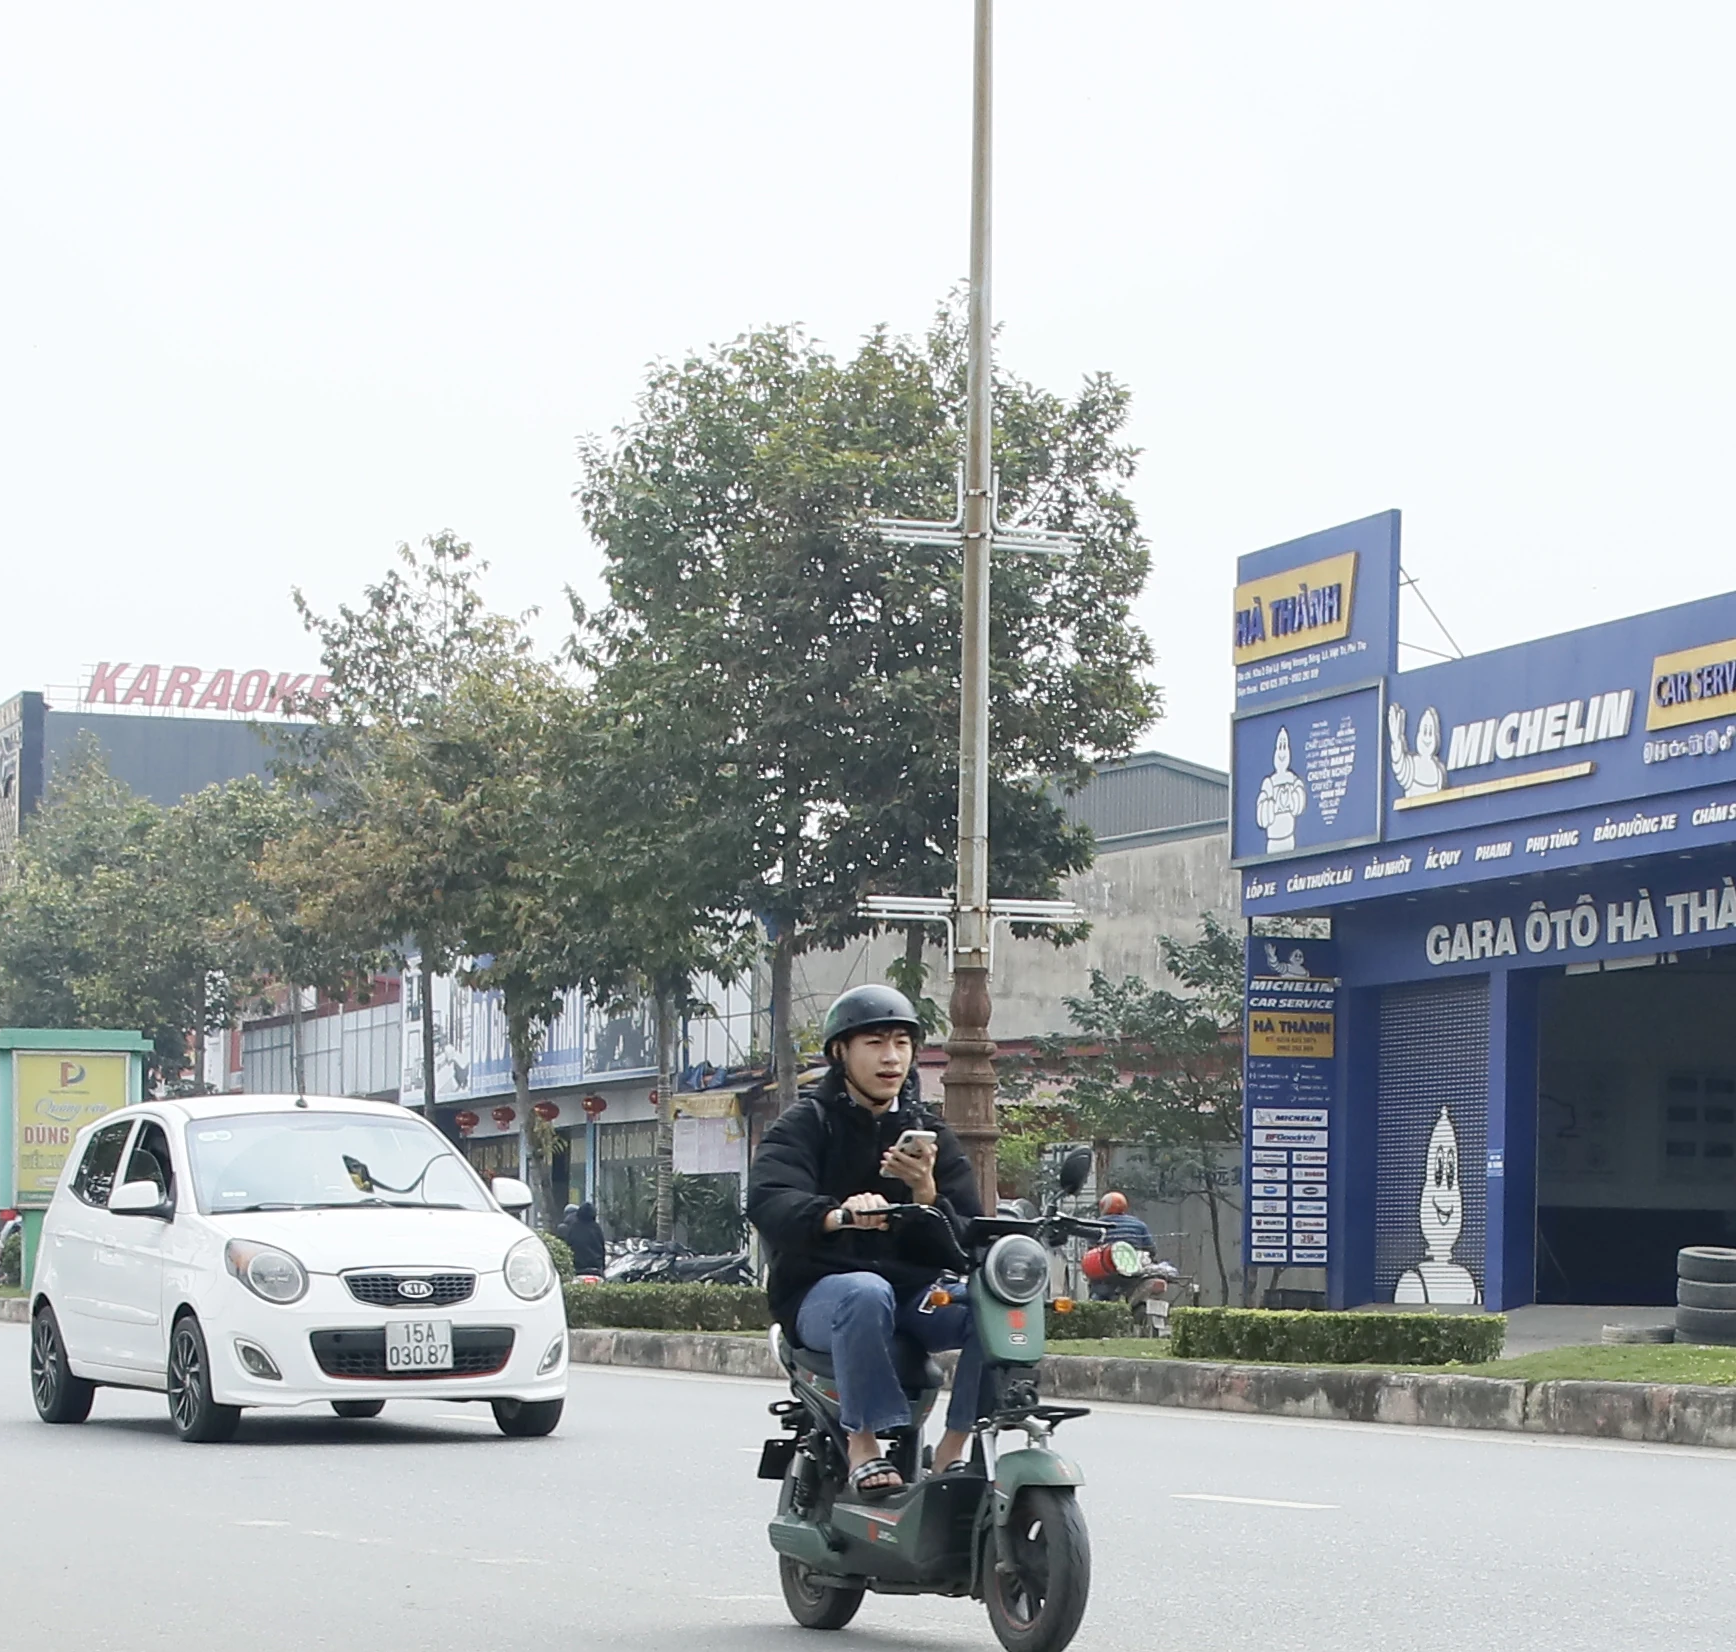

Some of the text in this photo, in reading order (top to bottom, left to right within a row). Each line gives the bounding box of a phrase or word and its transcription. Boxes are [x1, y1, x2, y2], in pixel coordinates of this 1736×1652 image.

[1235, 583, 1342, 648] HÀ THÀNH
[1654, 669, 1692, 707] CAR
[1447, 688, 1636, 772] MICHELIN
[1692, 801, 1729, 826] CHĂM
[1593, 813, 1678, 842] BẢO DƯỠNG XE
[1475, 841, 1513, 862] PHANH
[1525, 828, 1580, 858] PHỤ TÙNG
[1439, 849, 1463, 870] QUY
[1246, 876, 1277, 900] LỐP XE
[1286, 872, 1307, 893] CÂN
[1335, 865, 1354, 884] LÁI
[1425, 916, 1518, 967] GARA
[1524, 893, 1601, 954] ÔTÔ
[1606, 887, 1660, 944] HÀ
[1249, 997, 1335, 1009] CAR SERVICE
[1253, 1016, 1331, 1034] HÀ THÀNH
[1274, 1114, 1324, 1122] MICHELIN
[404, 1283, 429, 1294] KIA
[403, 1322, 436, 1344] 15A
[389, 1343, 450, 1367] 030.87
